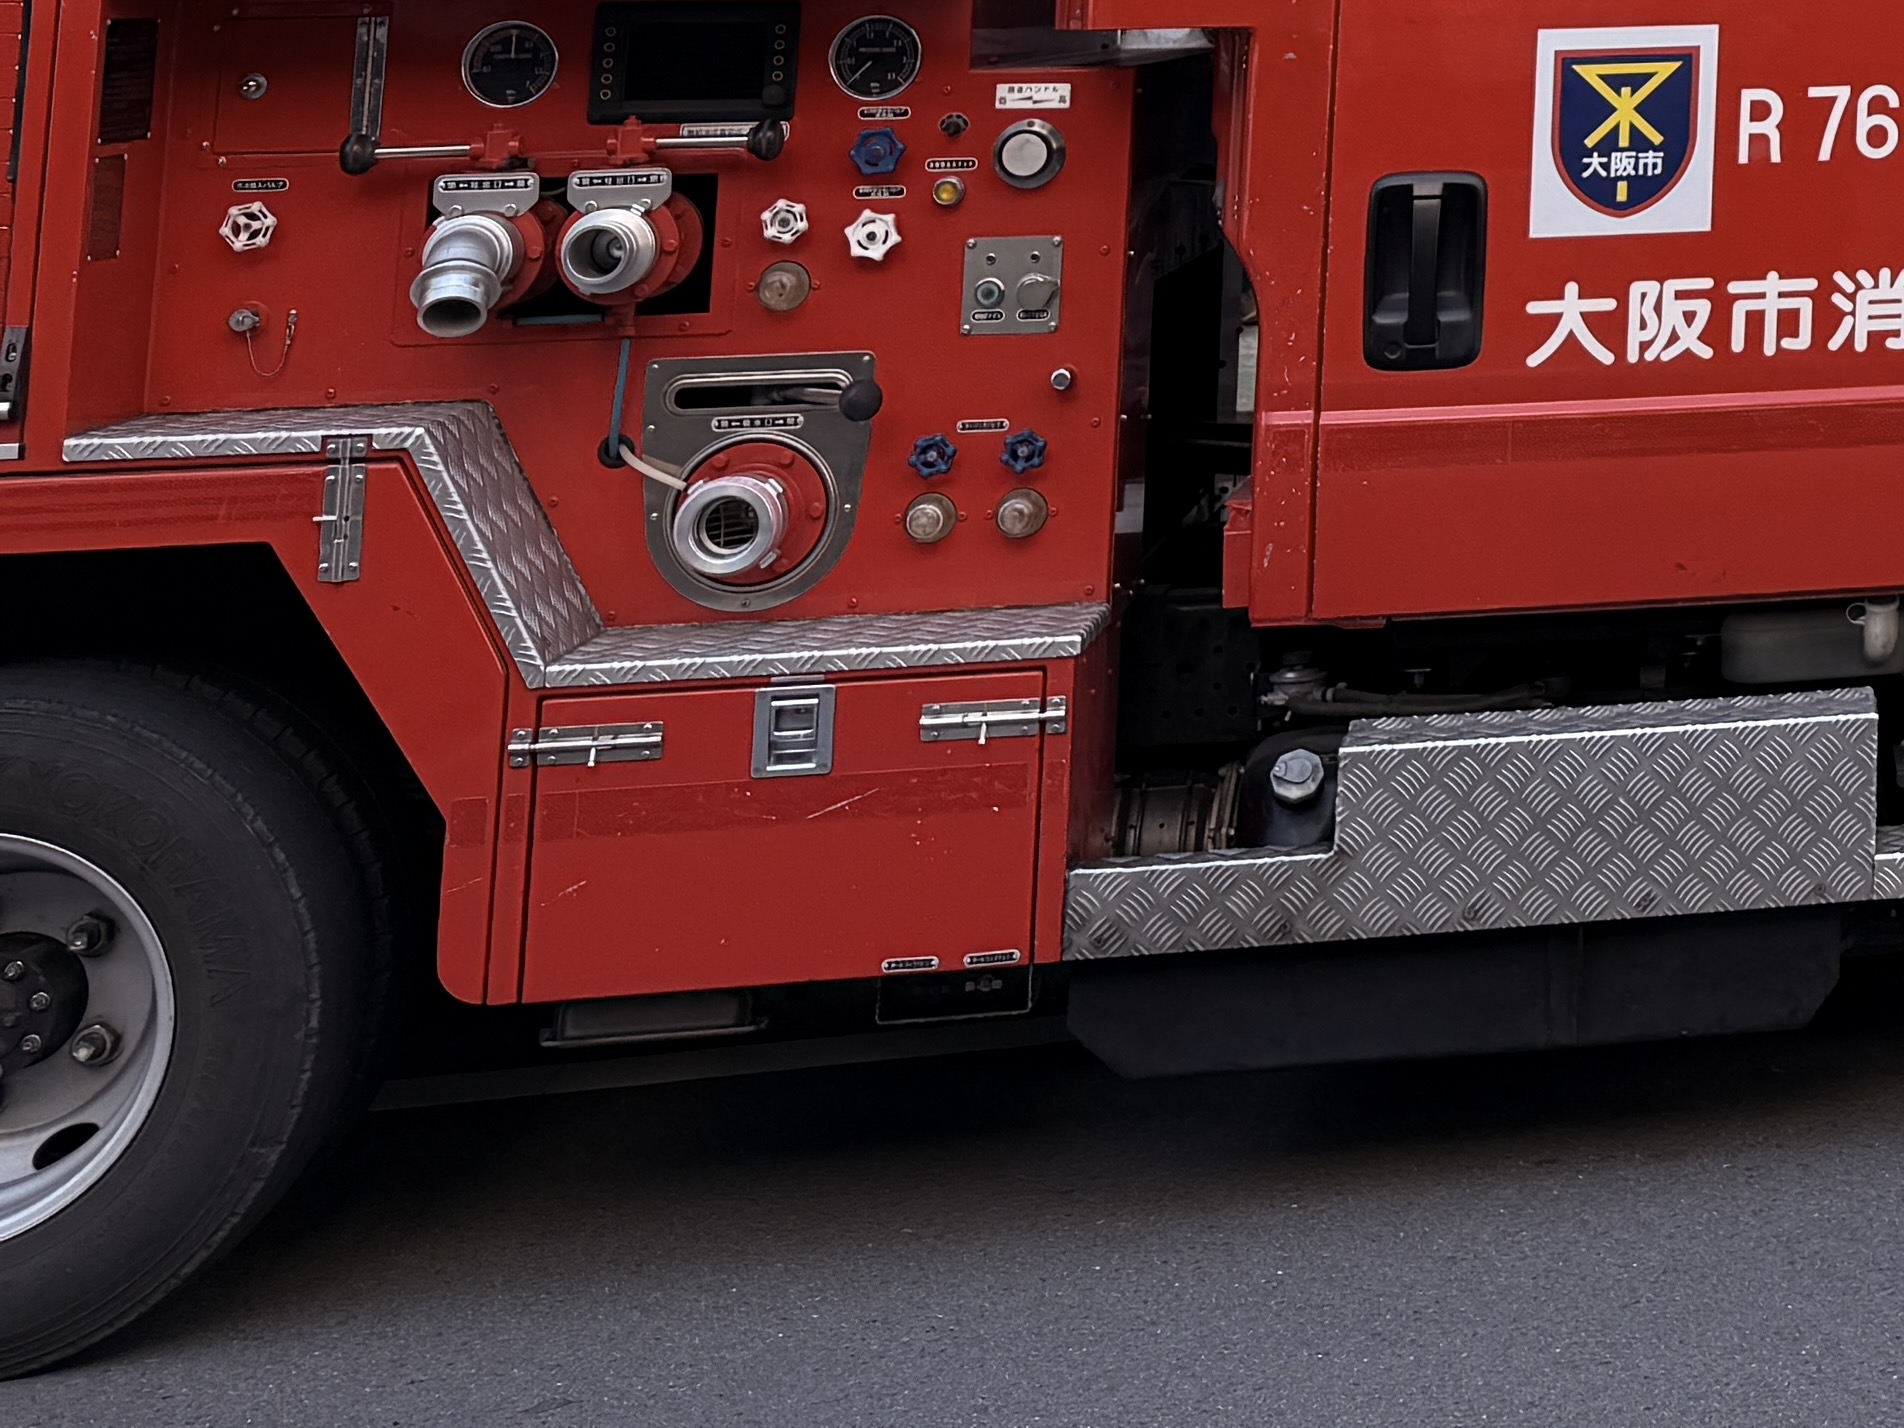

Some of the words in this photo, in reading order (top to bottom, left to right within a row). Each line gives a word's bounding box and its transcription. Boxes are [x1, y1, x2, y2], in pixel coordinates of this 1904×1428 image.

[1581, 150, 1665, 179] 大阪市
[1737, 87, 1782, 166] R
[1806, 83, 1901, 162] 76
[28, 761, 253, 1008] YOKOHAMA
